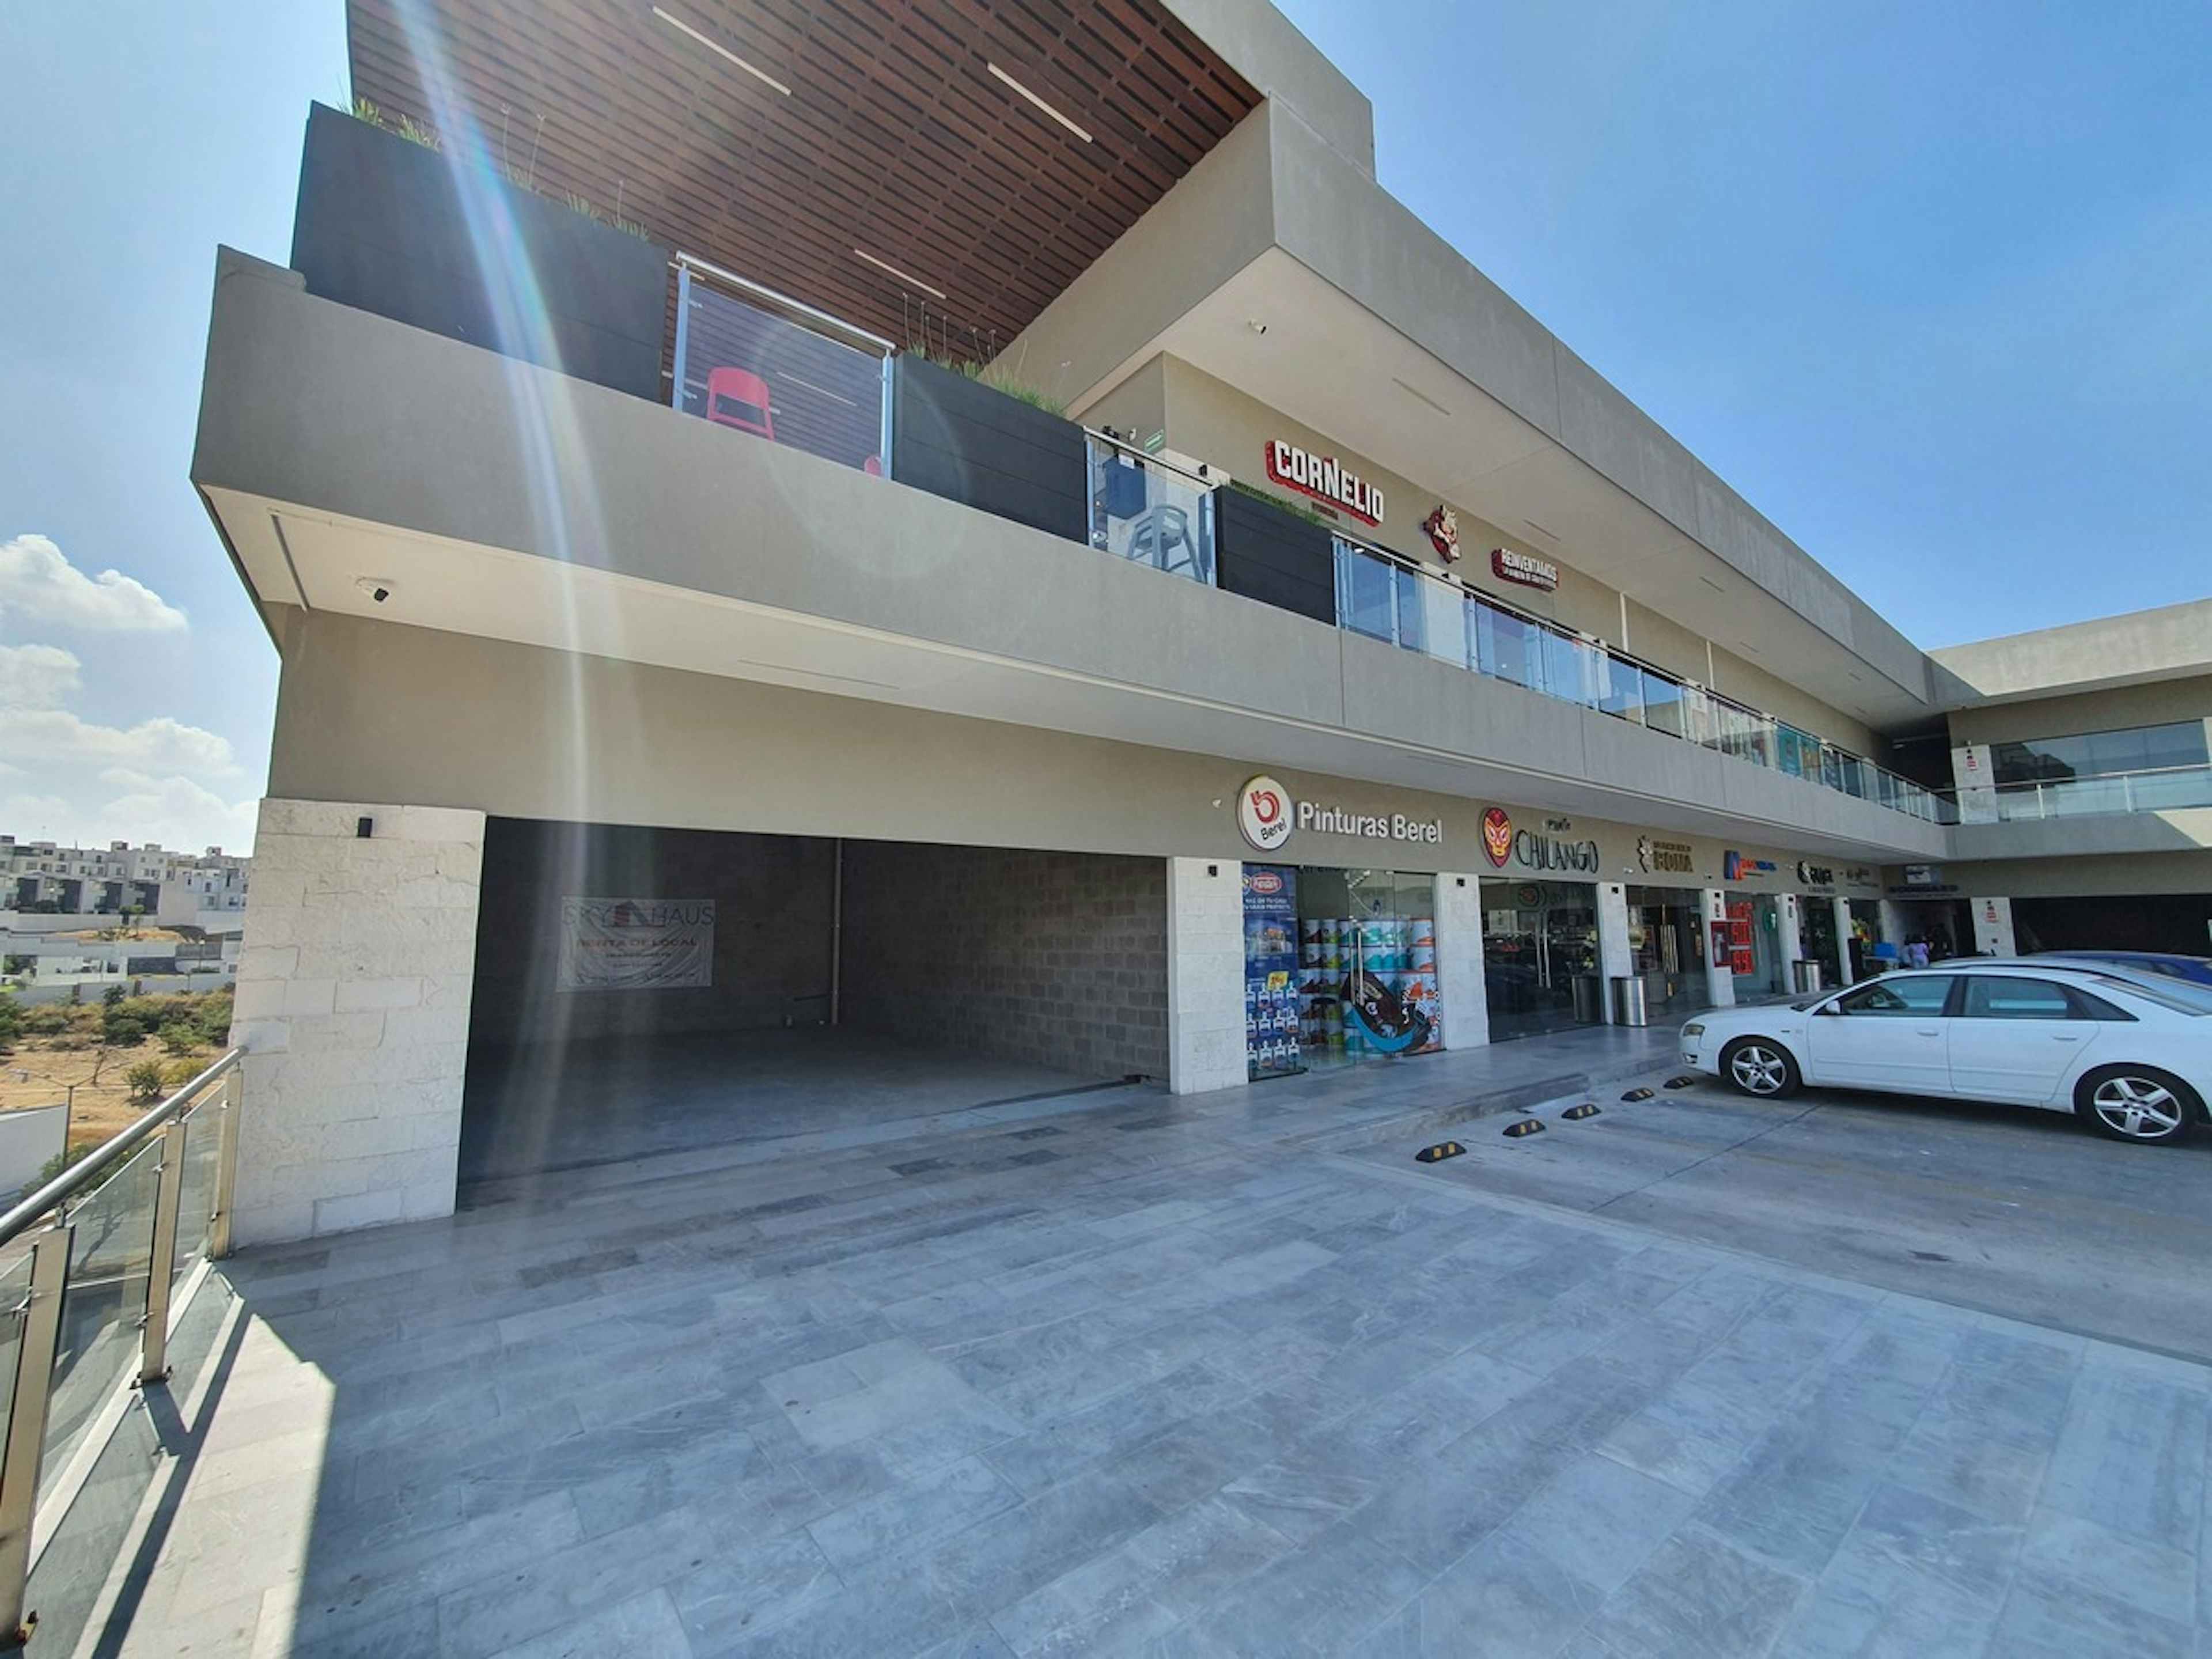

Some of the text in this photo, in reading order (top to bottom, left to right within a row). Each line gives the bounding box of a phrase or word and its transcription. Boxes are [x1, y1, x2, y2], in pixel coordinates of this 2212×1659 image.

[1274, 439, 1383, 522] CORNELIO
[1261, 819, 1287, 840] Berel
[1297, 801, 1442, 843] Pinturas Berel
[1516, 830, 1599, 874] CHILANGO
[652, 906, 714, 925] HAUS
